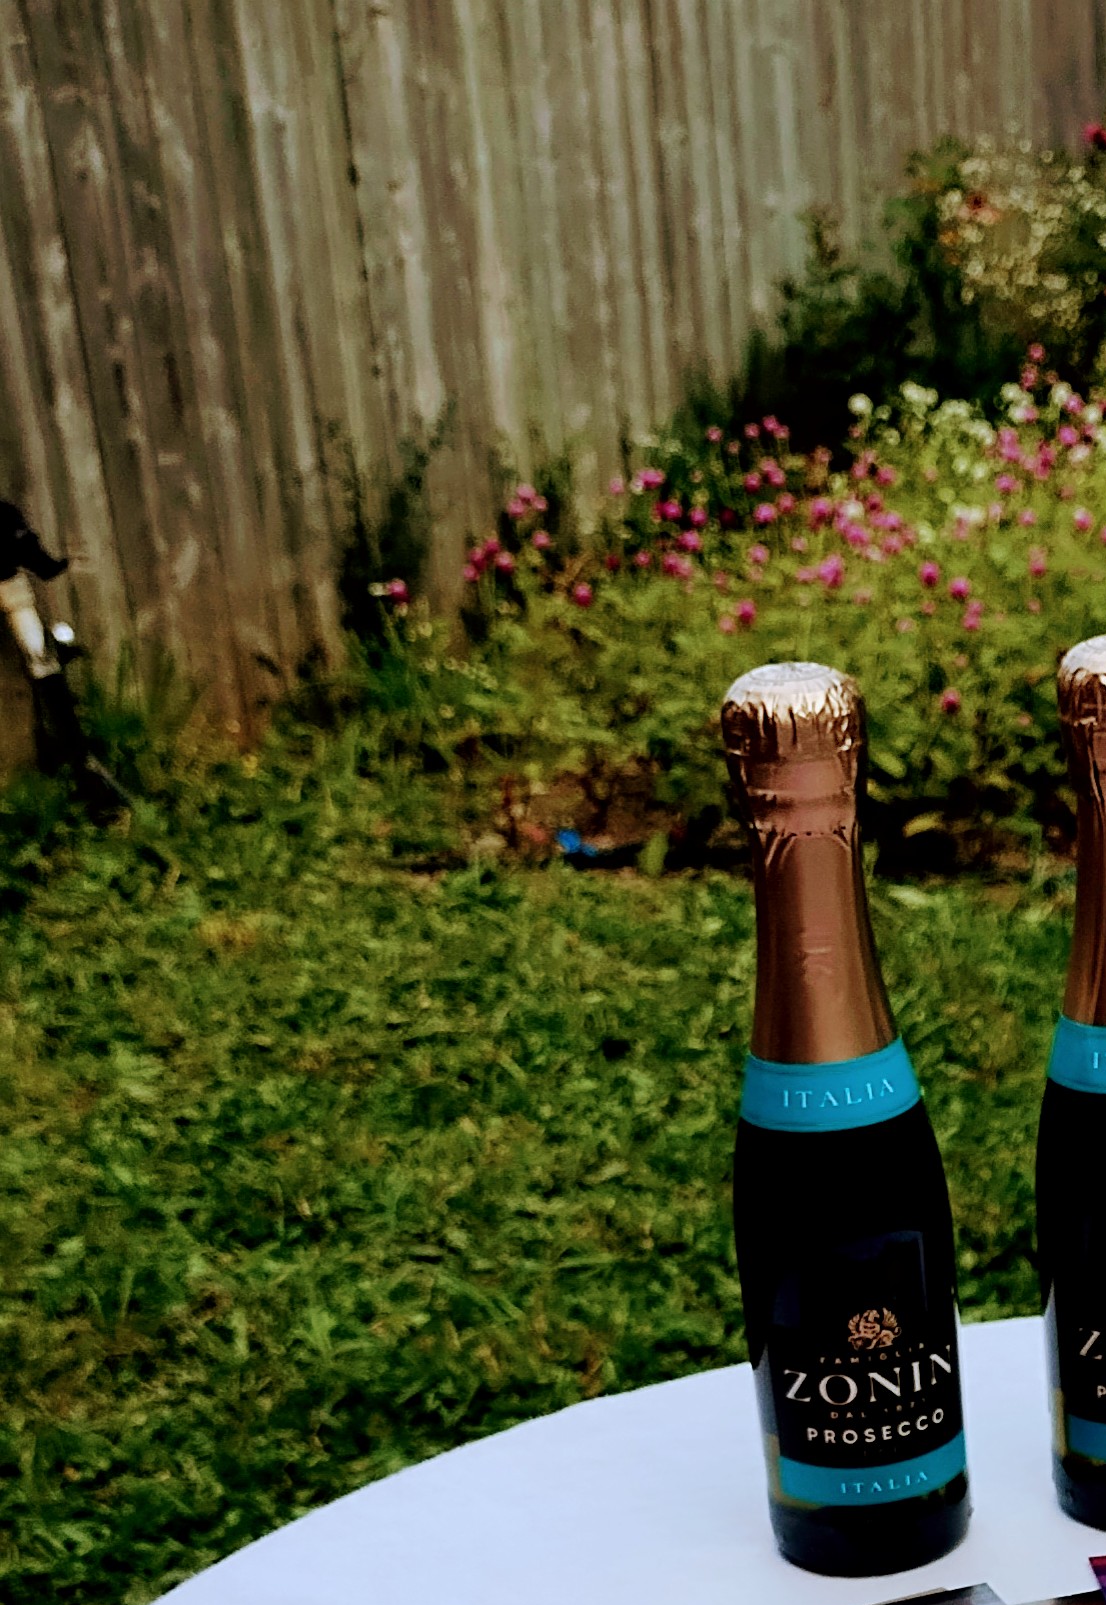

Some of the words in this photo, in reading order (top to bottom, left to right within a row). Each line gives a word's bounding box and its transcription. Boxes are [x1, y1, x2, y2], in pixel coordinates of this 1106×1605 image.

[783, 1079, 894, 1108] ITALIA
[783, 1344, 952, 1406] ZONIN
[806, 1408, 944, 1444] PROSECCO
[839, 1471, 928, 1494] ITALIA
